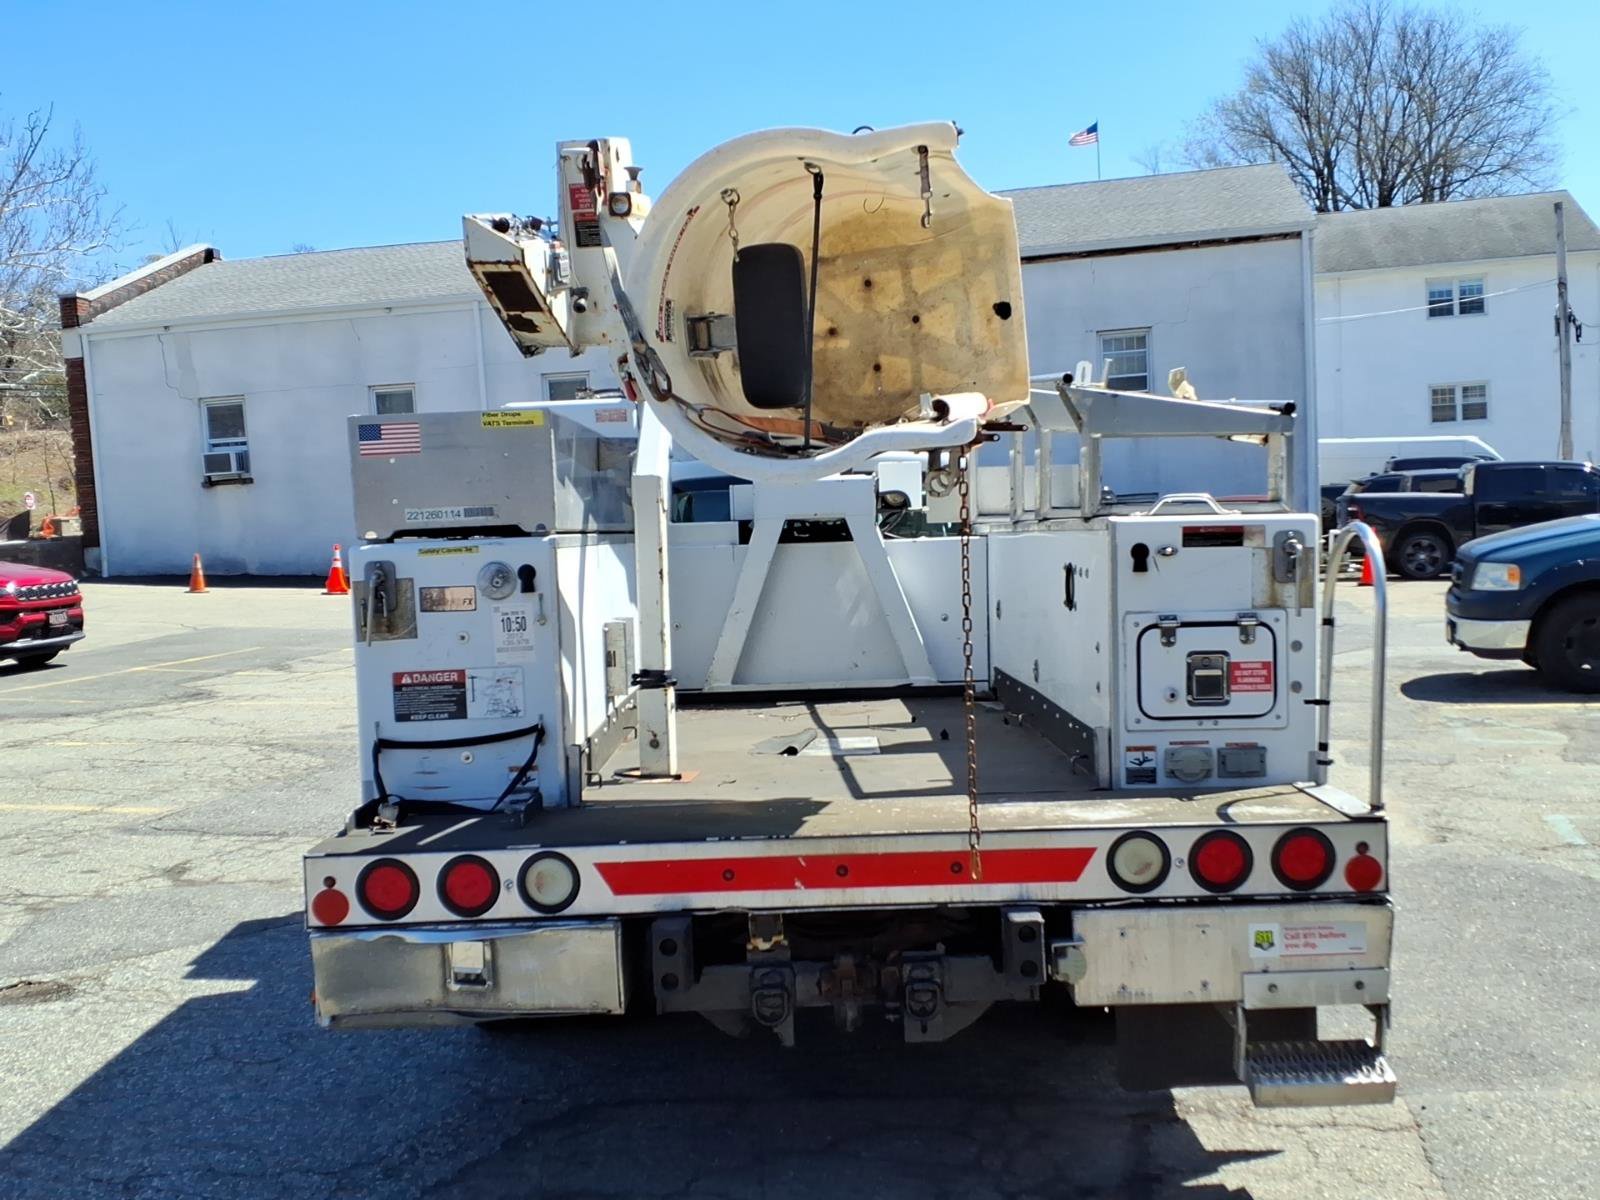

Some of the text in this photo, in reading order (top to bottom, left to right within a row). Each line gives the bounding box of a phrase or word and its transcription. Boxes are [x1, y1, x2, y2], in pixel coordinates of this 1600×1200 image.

[406, 510, 461, 520] 221260114
[501, 616, 527, 633] 10:50
[412, 672, 458, 683] DANGER
